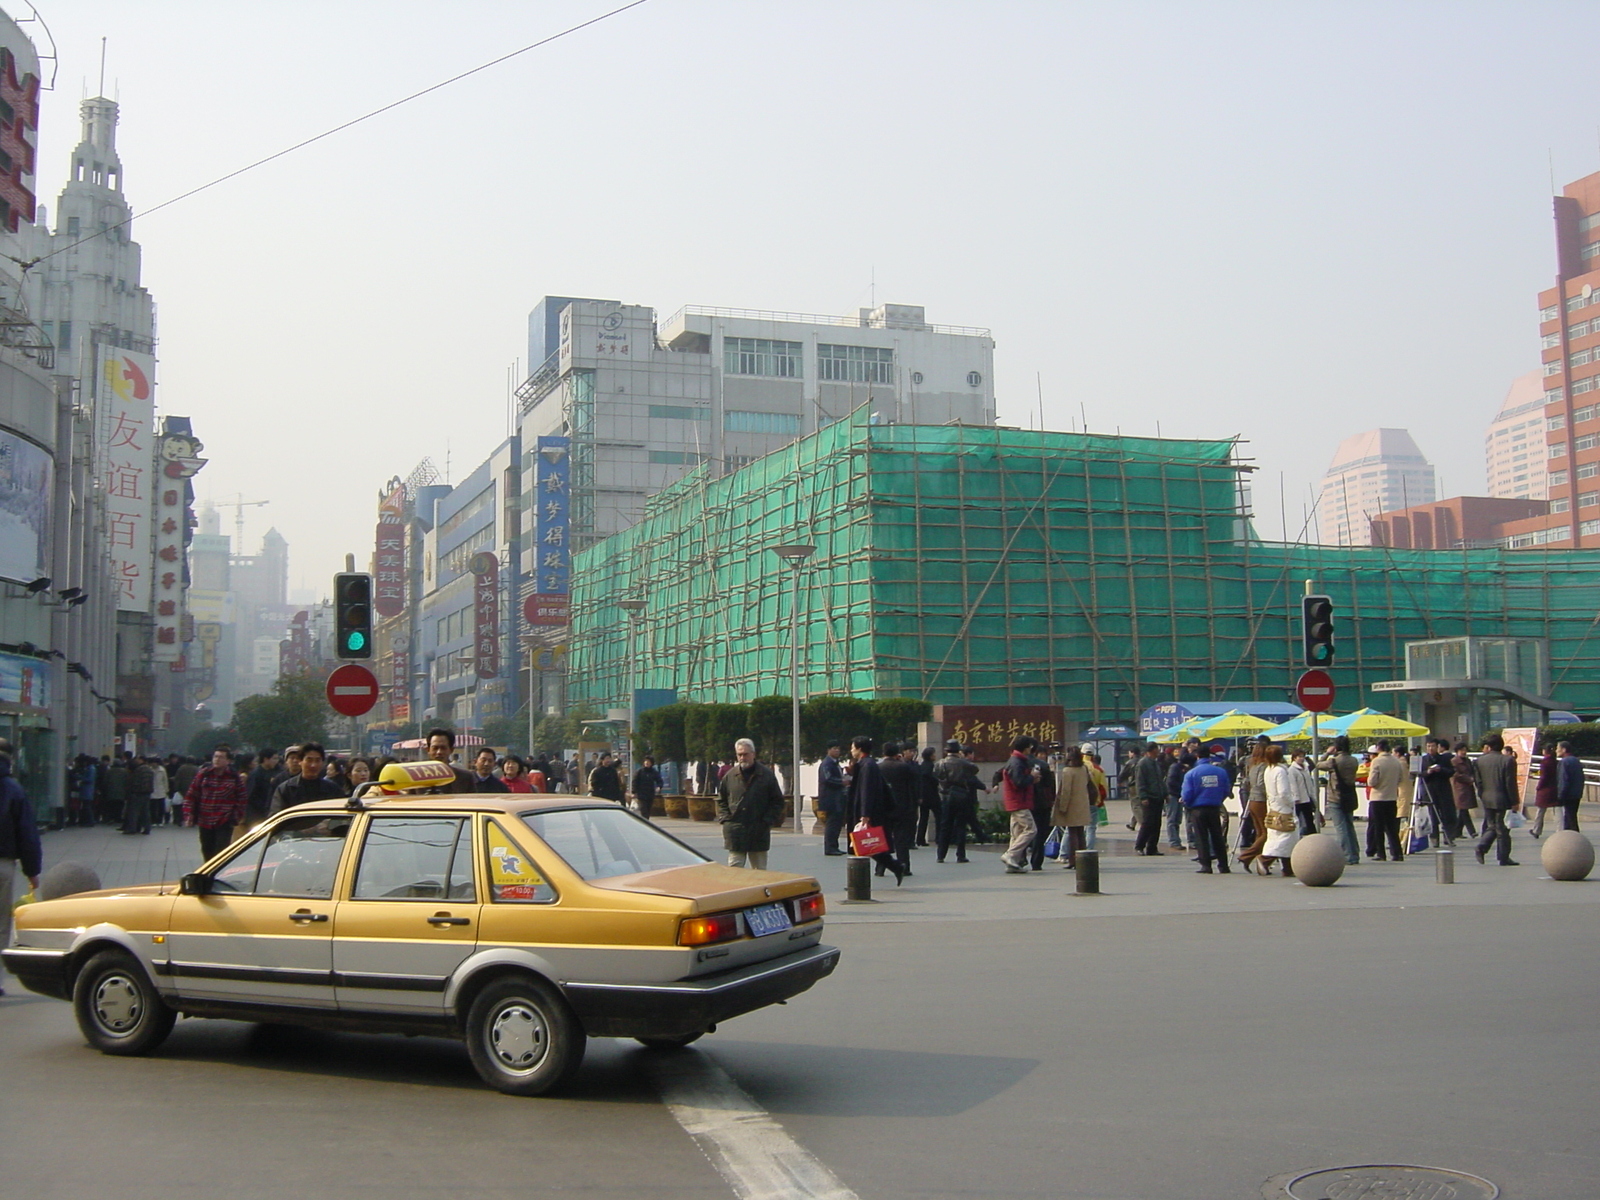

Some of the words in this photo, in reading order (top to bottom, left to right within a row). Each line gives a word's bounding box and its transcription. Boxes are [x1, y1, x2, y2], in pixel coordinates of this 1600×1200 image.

[107, 410, 143, 600] 友谊百货
[541, 471, 566, 591] 戴梦得珠宝
[379, 538, 402, 599] 天美珠宝
[1160, 705, 1177, 713] PEPSI
[951, 718, 1057, 747] 南京路步行街
[408, 764, 450, 778] TAXI
